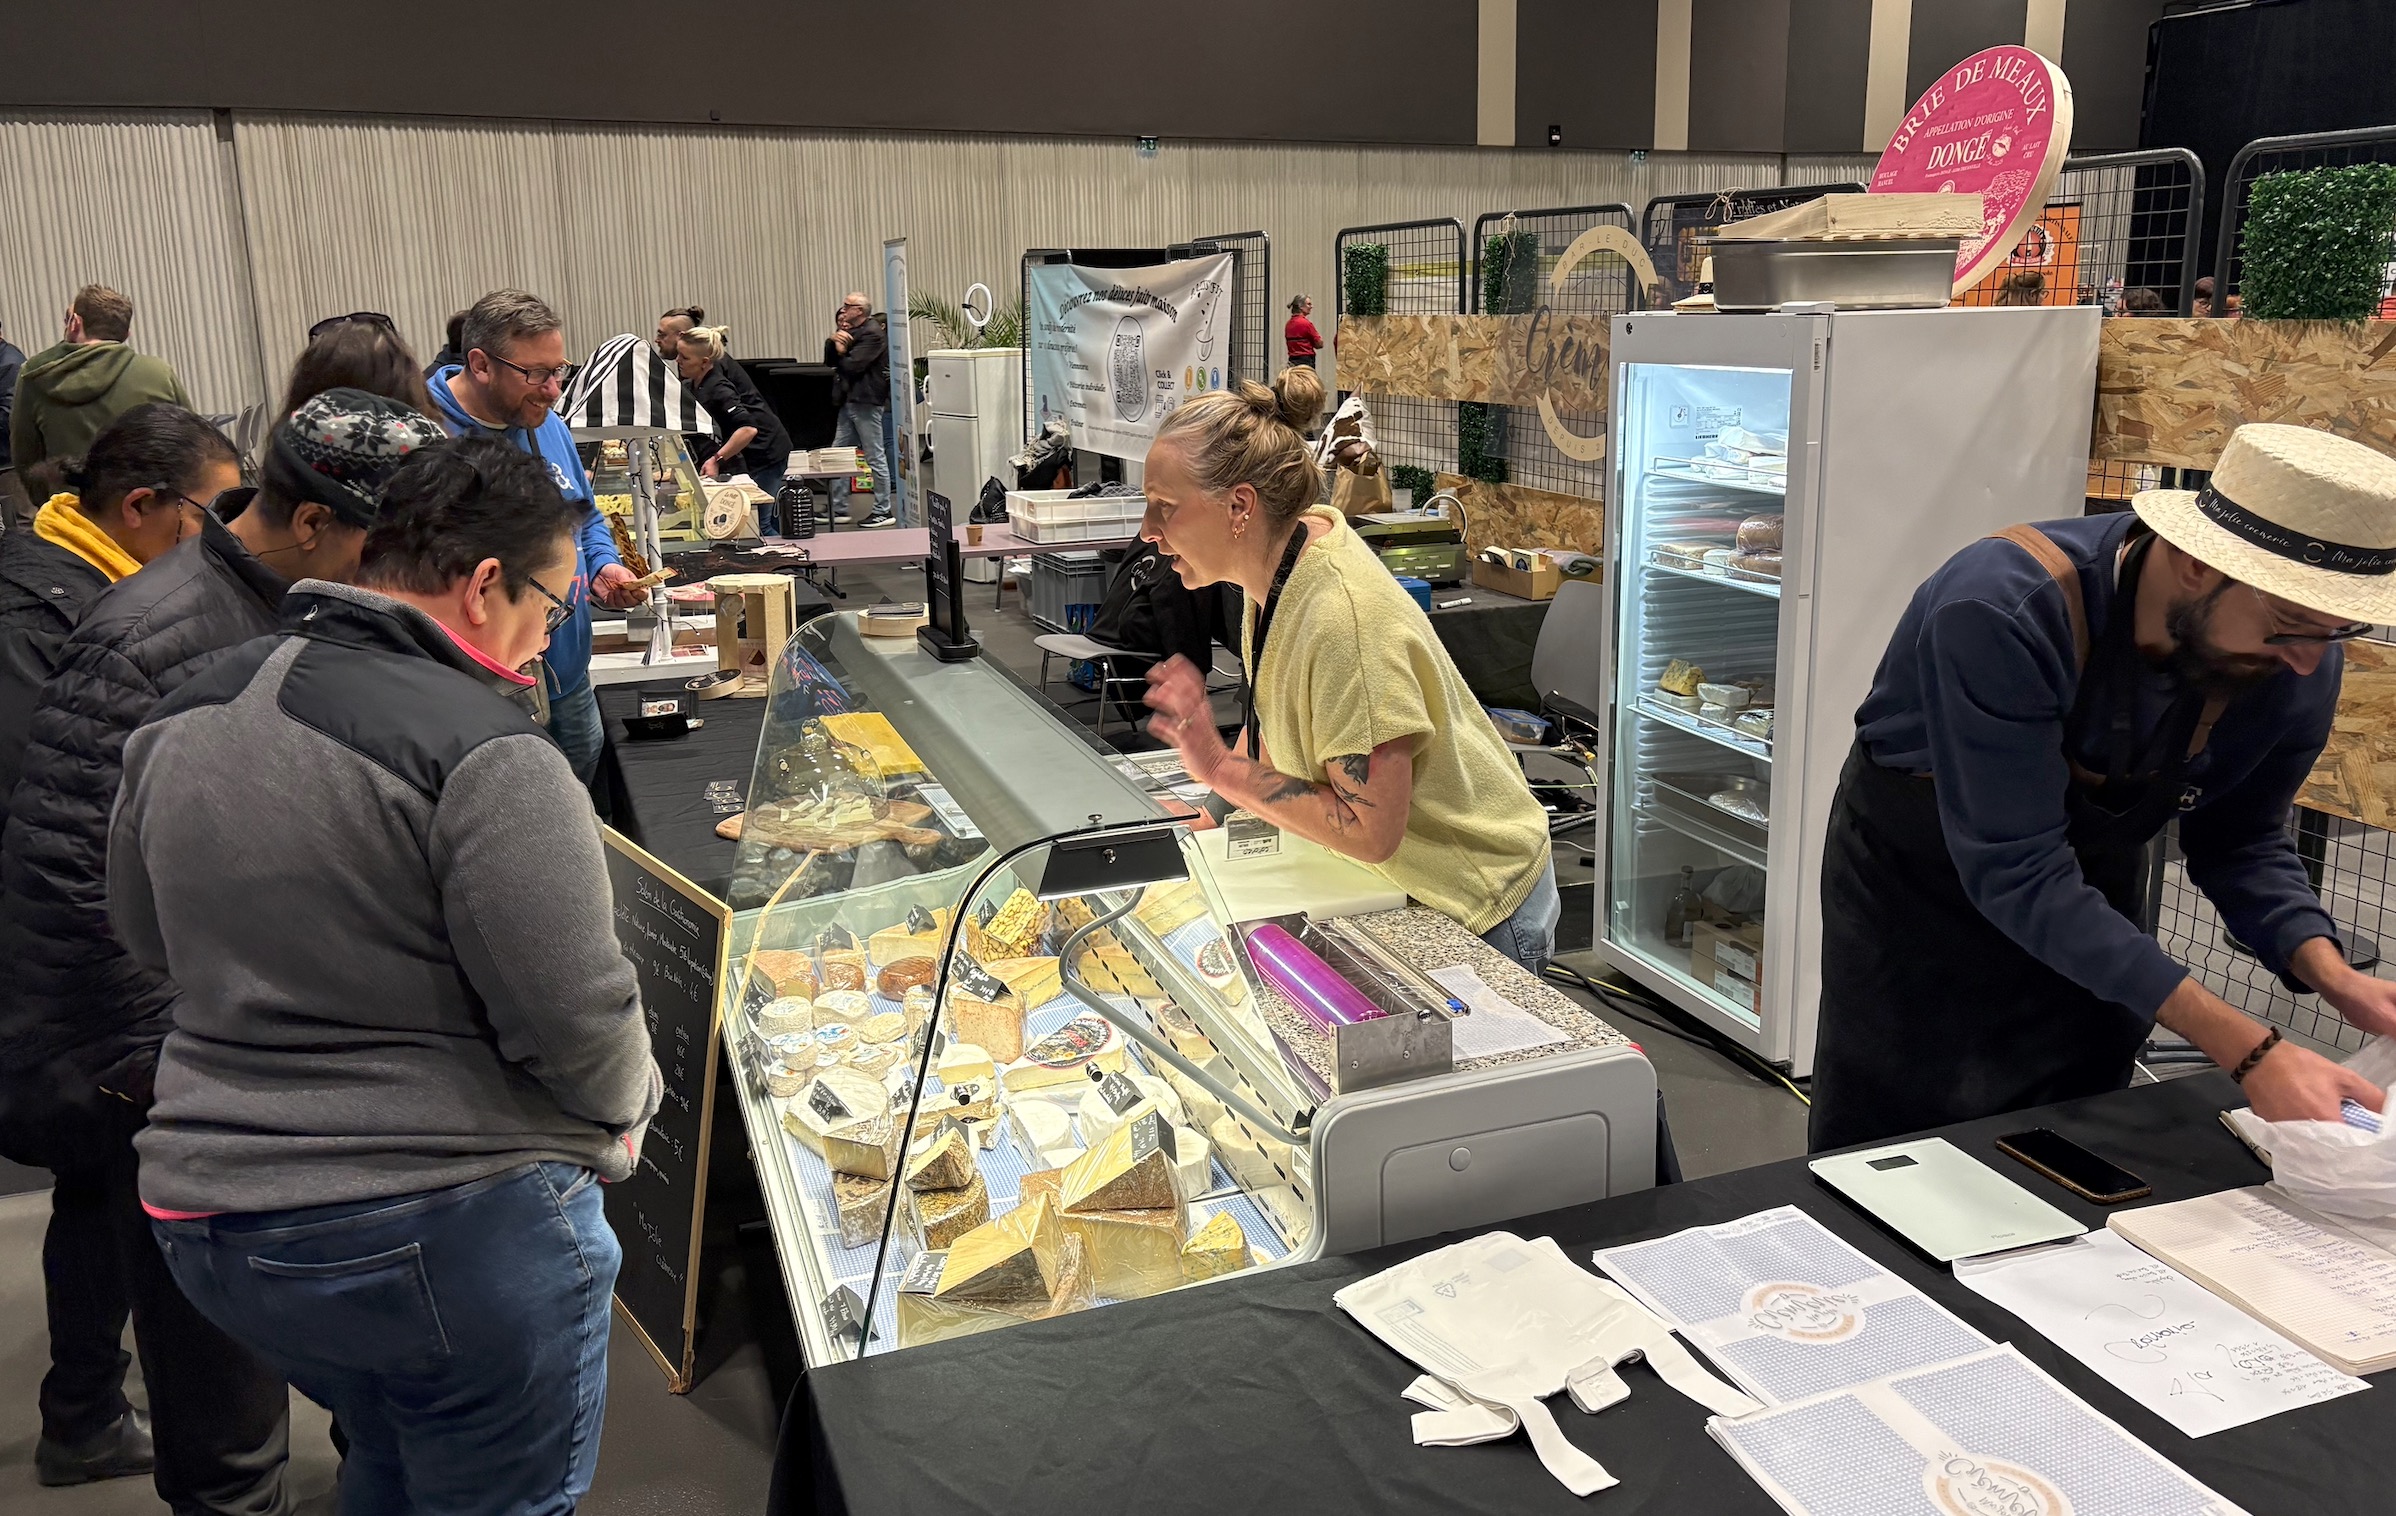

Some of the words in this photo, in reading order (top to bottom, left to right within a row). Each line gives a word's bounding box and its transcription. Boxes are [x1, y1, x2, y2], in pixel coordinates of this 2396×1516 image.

[1892, 86, 1946, 154] BRIE
[1955, 59, 1987, 92] DE
[1988, 55, 2046, 126] MEAUX
[1924, 118, 1975, 139] APPELLATION
[1974, 108, 2015, 128] D'ORIGINE
[1563, 234, 1645, 269] BAR-LE-DUC
[1059, 290, 1092, 321] Découvrez
[1093, 288, 1108, 303] nos
[1108, 284, 1134, 302] délices
[1130, 286, 1151, 308] faits
[1150, 295, 1178, 324] maison
[1526, 304, 1609, 391] Crèm
[1157, 381, 1175, 391] COLLECT
[1548, 416, 1585, 454] DEPUIS
[2208, 498, 2221, 513] Ma
[2217, 509, 2243, 525] jolie
[2331, 550, 2353, 563] Ma
[2352, 555, 2382, 569] jolie
